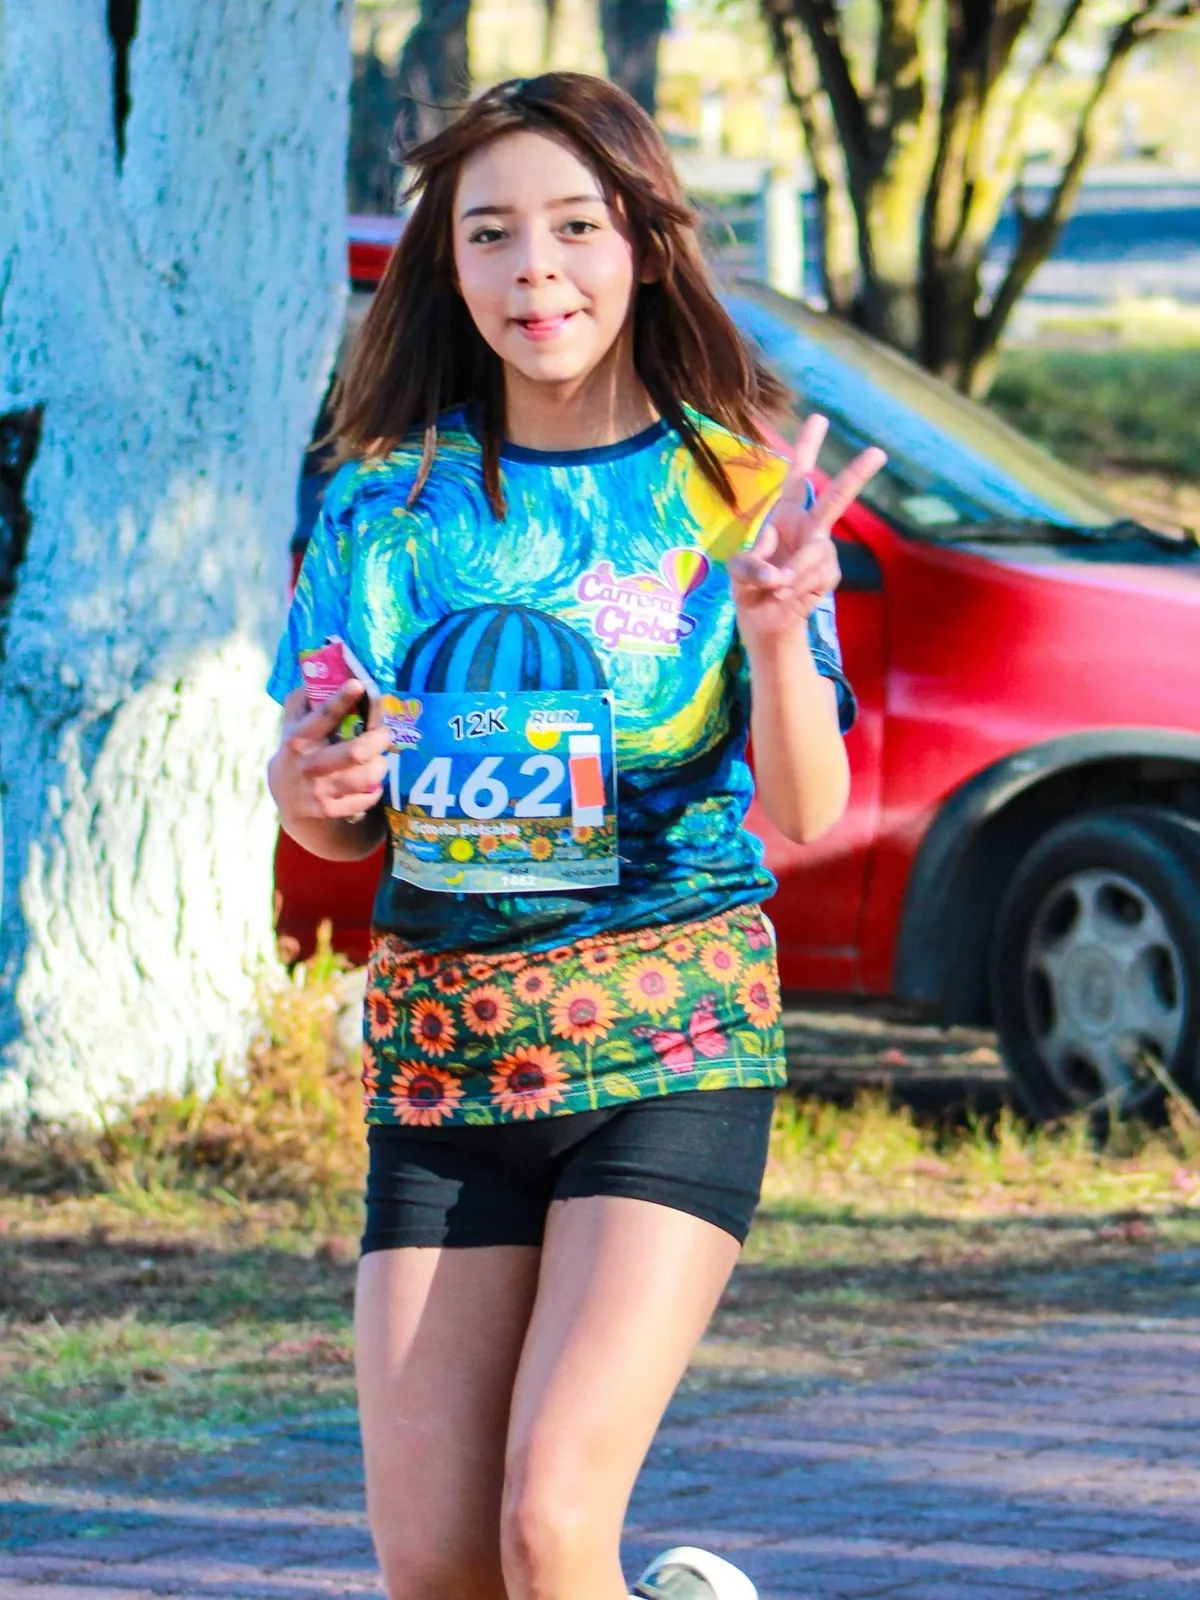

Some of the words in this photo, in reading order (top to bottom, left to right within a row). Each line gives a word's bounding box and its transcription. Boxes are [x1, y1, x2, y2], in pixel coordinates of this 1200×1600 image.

[595, 605, 694, 648] Globo
[448, 706, 509, 741] 12K
[530, 709, 580, 724] RUN
